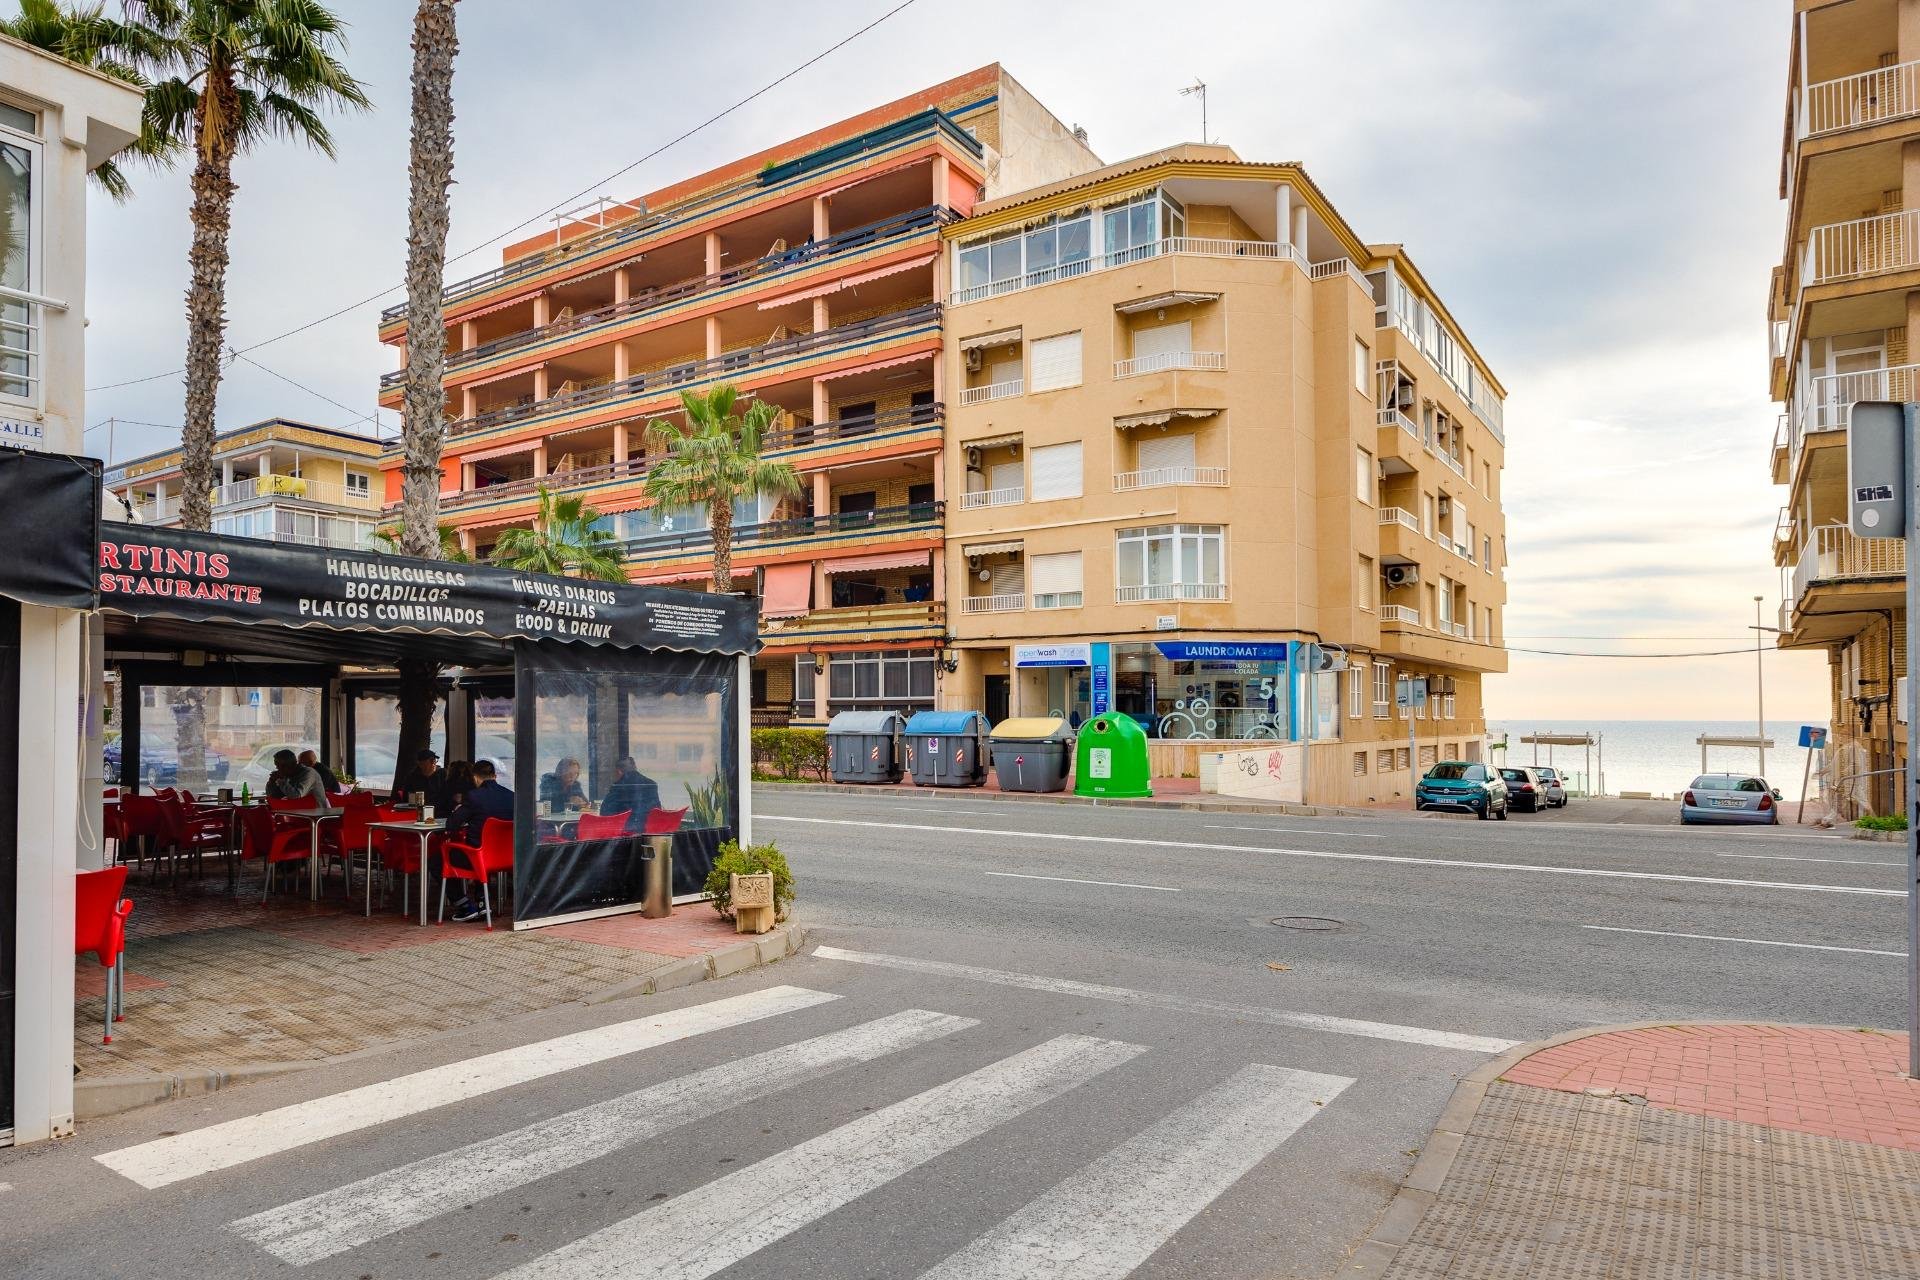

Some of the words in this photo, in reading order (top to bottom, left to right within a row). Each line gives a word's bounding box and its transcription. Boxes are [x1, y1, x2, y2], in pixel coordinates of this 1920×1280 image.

[0, 421, 42, 438] ALLE
[326, 558, 466, 587] HAMBURGUESAS
[345, 582, 450, 603] BOCADILLOS
[565, 585, 616, 605] DIARIOS
[299, 598, 369, 619] PLATOS
[375, 604, 485, 626] COMBINADOS
[537, 598, 596, 619] PAELLAS
[515, 613, 553, 631] FOOD
[557, 618, 567, 634] &
[570, 620, 613, 639] DRINK
[1185, 646, 1258, 656] LAUNDROMAT
